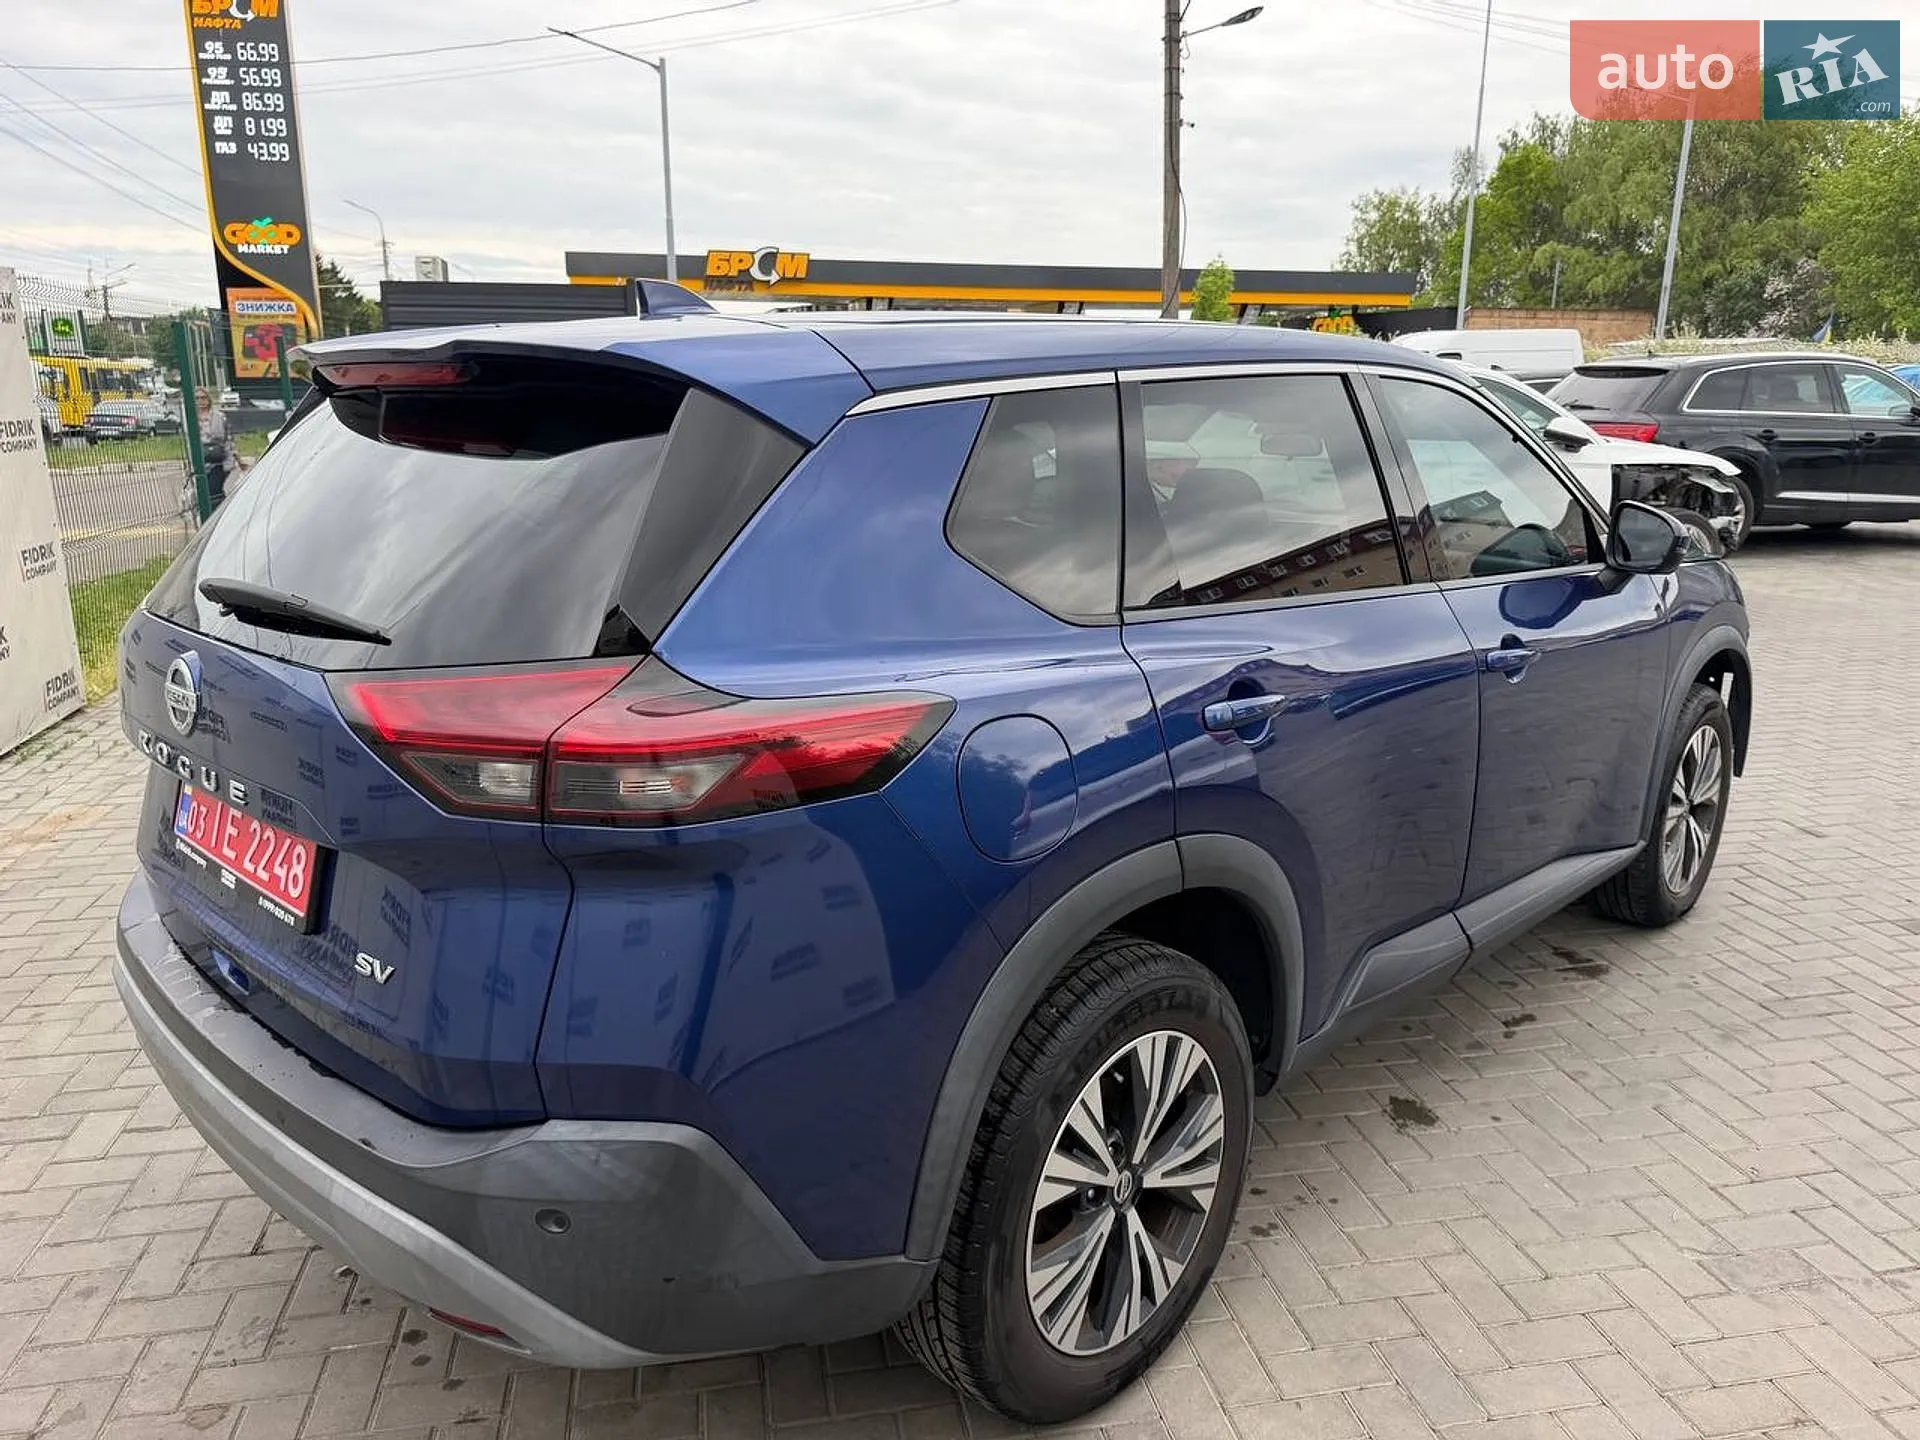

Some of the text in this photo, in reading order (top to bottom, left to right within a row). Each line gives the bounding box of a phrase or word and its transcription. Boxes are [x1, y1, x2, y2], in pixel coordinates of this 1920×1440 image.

[193, 17, 242, 29] НАФТА
[204, 41, 225, 54] 95
[236, 42, 279, 62] 66.99
[239, 67, 282, 87] 56.99
[242, 92, 285, 112] 86.99
[245, 117, 288, 137] 81.99
[215, 141, 290, 163] ГАЗ 43.99
[224, 221, 302, 247] GOOD
[238, 243, 290, 255] MARKET
[706, 247, 810, 286] БРСМ
[237, 302, 295, 313] ЗНИЖКА
[21, 541, 55, 566] FIDRIK
[46, 666, 76, 697] FIDRIK
[48, 685, 80, 710] COMPANY
[139, 730, 250, 805] ROGUE
[188, 800, 207, 840] 03
[243, 819, 306, 899] 2248
[354, 951, 395, 985] SV
